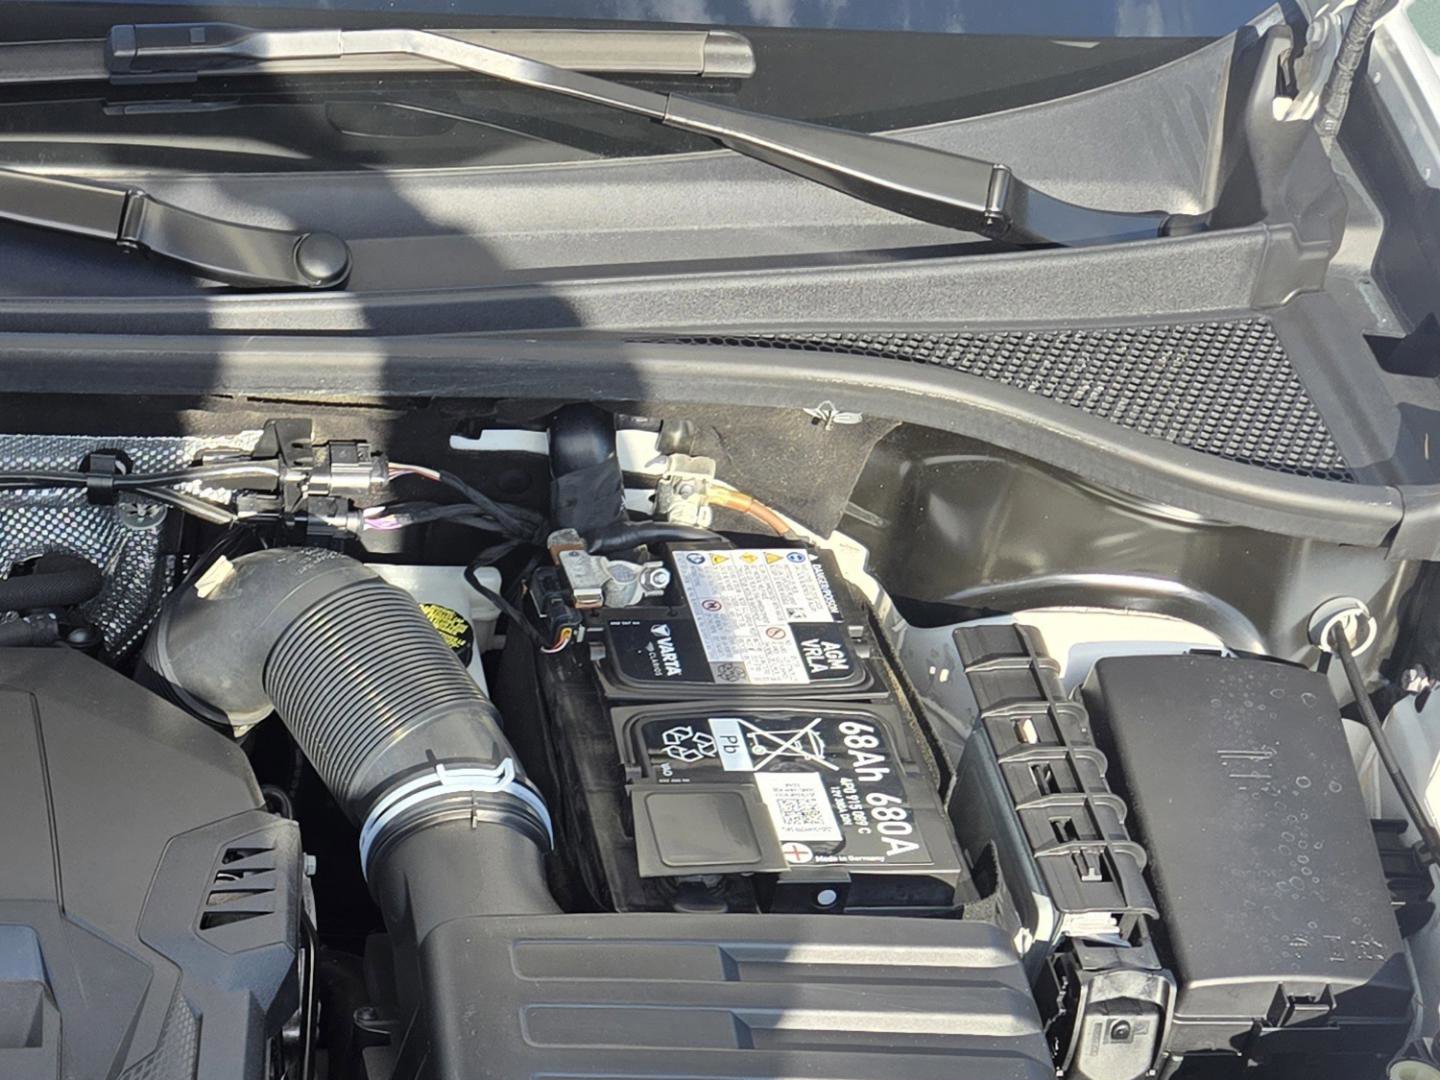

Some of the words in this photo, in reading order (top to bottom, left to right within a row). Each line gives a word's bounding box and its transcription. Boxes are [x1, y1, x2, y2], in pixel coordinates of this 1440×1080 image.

[657, 636, 682, 676] VARTA
[800, 638, 829, 673] VRLA
[821, 640, 849, 670] AGM
[720, 735, 740, 754] Pb
[838, 721, 890, 782] 68Ah
[865, 792, 920, 856] 680A
